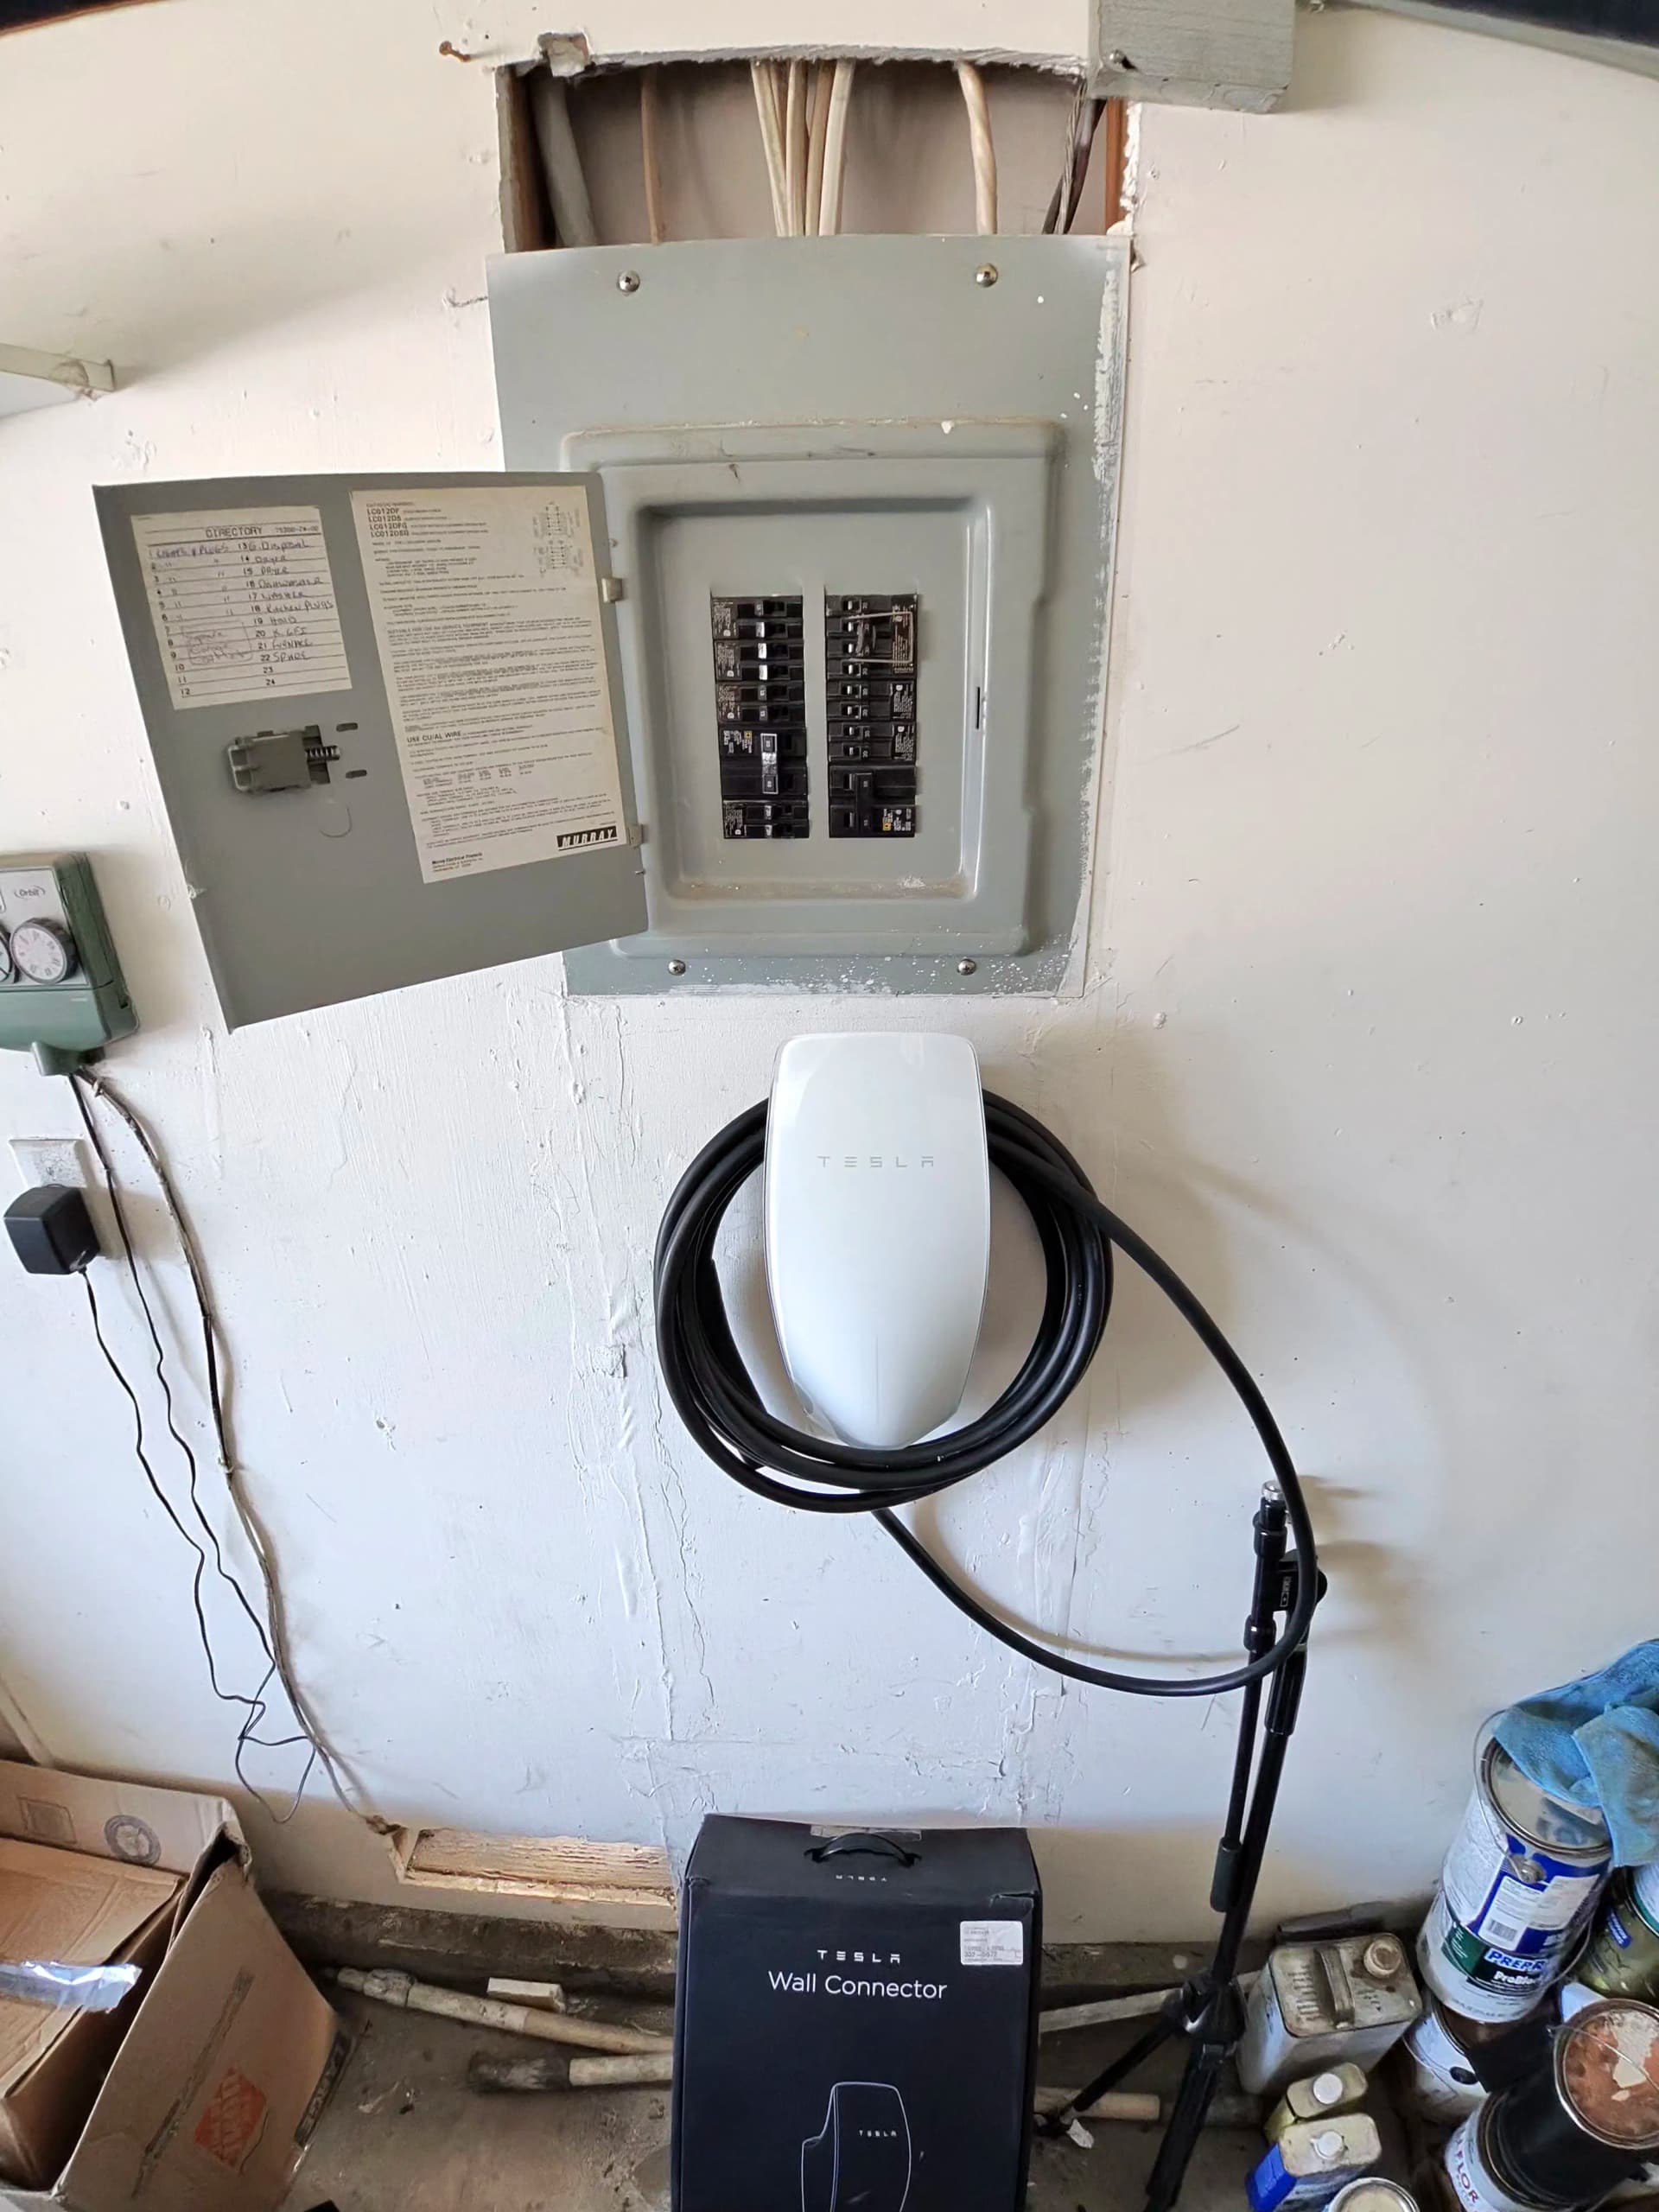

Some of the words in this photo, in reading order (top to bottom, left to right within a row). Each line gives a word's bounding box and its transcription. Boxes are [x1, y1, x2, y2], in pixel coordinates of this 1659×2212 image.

[205, 525, 263, 539] DIRECTORY
[248, 592, 257, 602] 17
[260, 653, 270, 662] 22
[175, 663, 185, 671] 10
[178, 676, 187, 684] 11
[181, 688, 190, 696] 12
[444, 730, 461, 739] WIRE
[562, 829, 614, 847] MURRAY
[817, 1155, 934, 1168] TESLA
[817, 1949, 900, 1964] TESLA
[1493, 1970, 1536, 1985] ProBlo
[768, 1970, 817, 1993] Wall
[824, 1974, 948, 1999] Connector
[859, 2129, 897, 2138] TESLA
